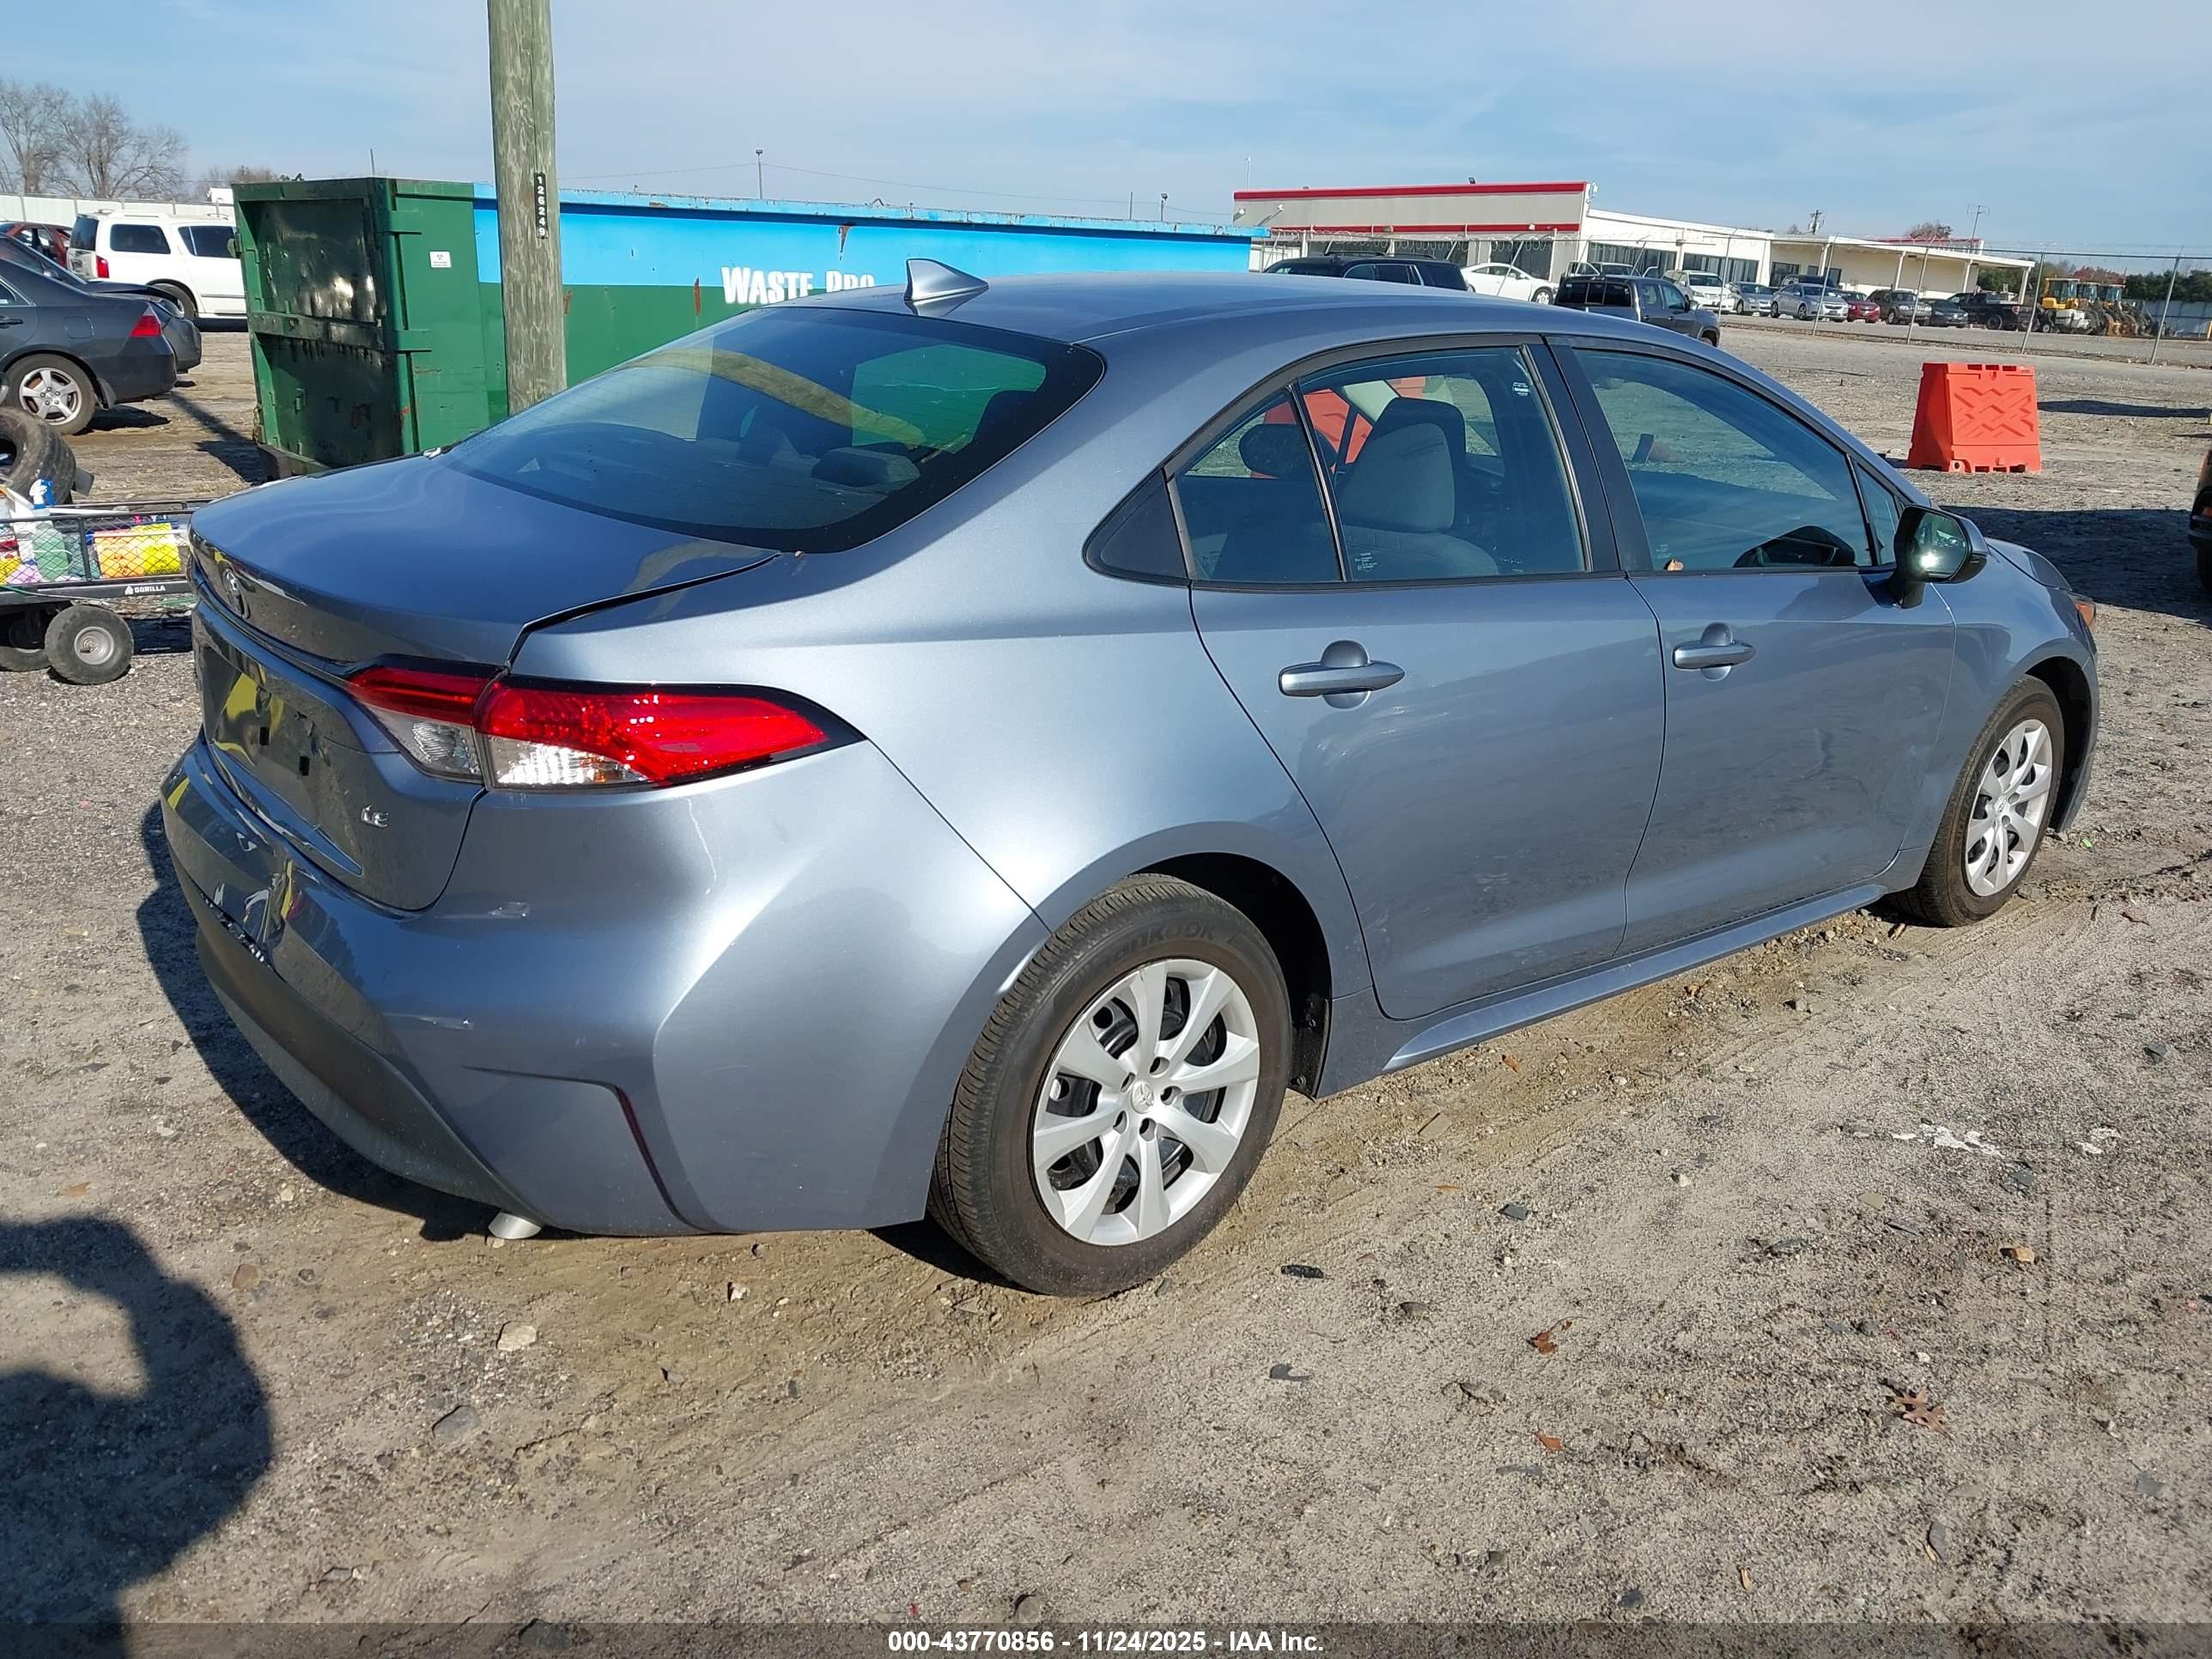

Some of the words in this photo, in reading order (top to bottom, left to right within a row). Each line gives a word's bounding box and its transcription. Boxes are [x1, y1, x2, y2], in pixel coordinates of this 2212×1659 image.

[537, 176, 546, 236] 126249
[720, 266, 814, 304] WASTE
[134, 585, 167, 593] GORILLA
[361, 805, 389, 828] LE
